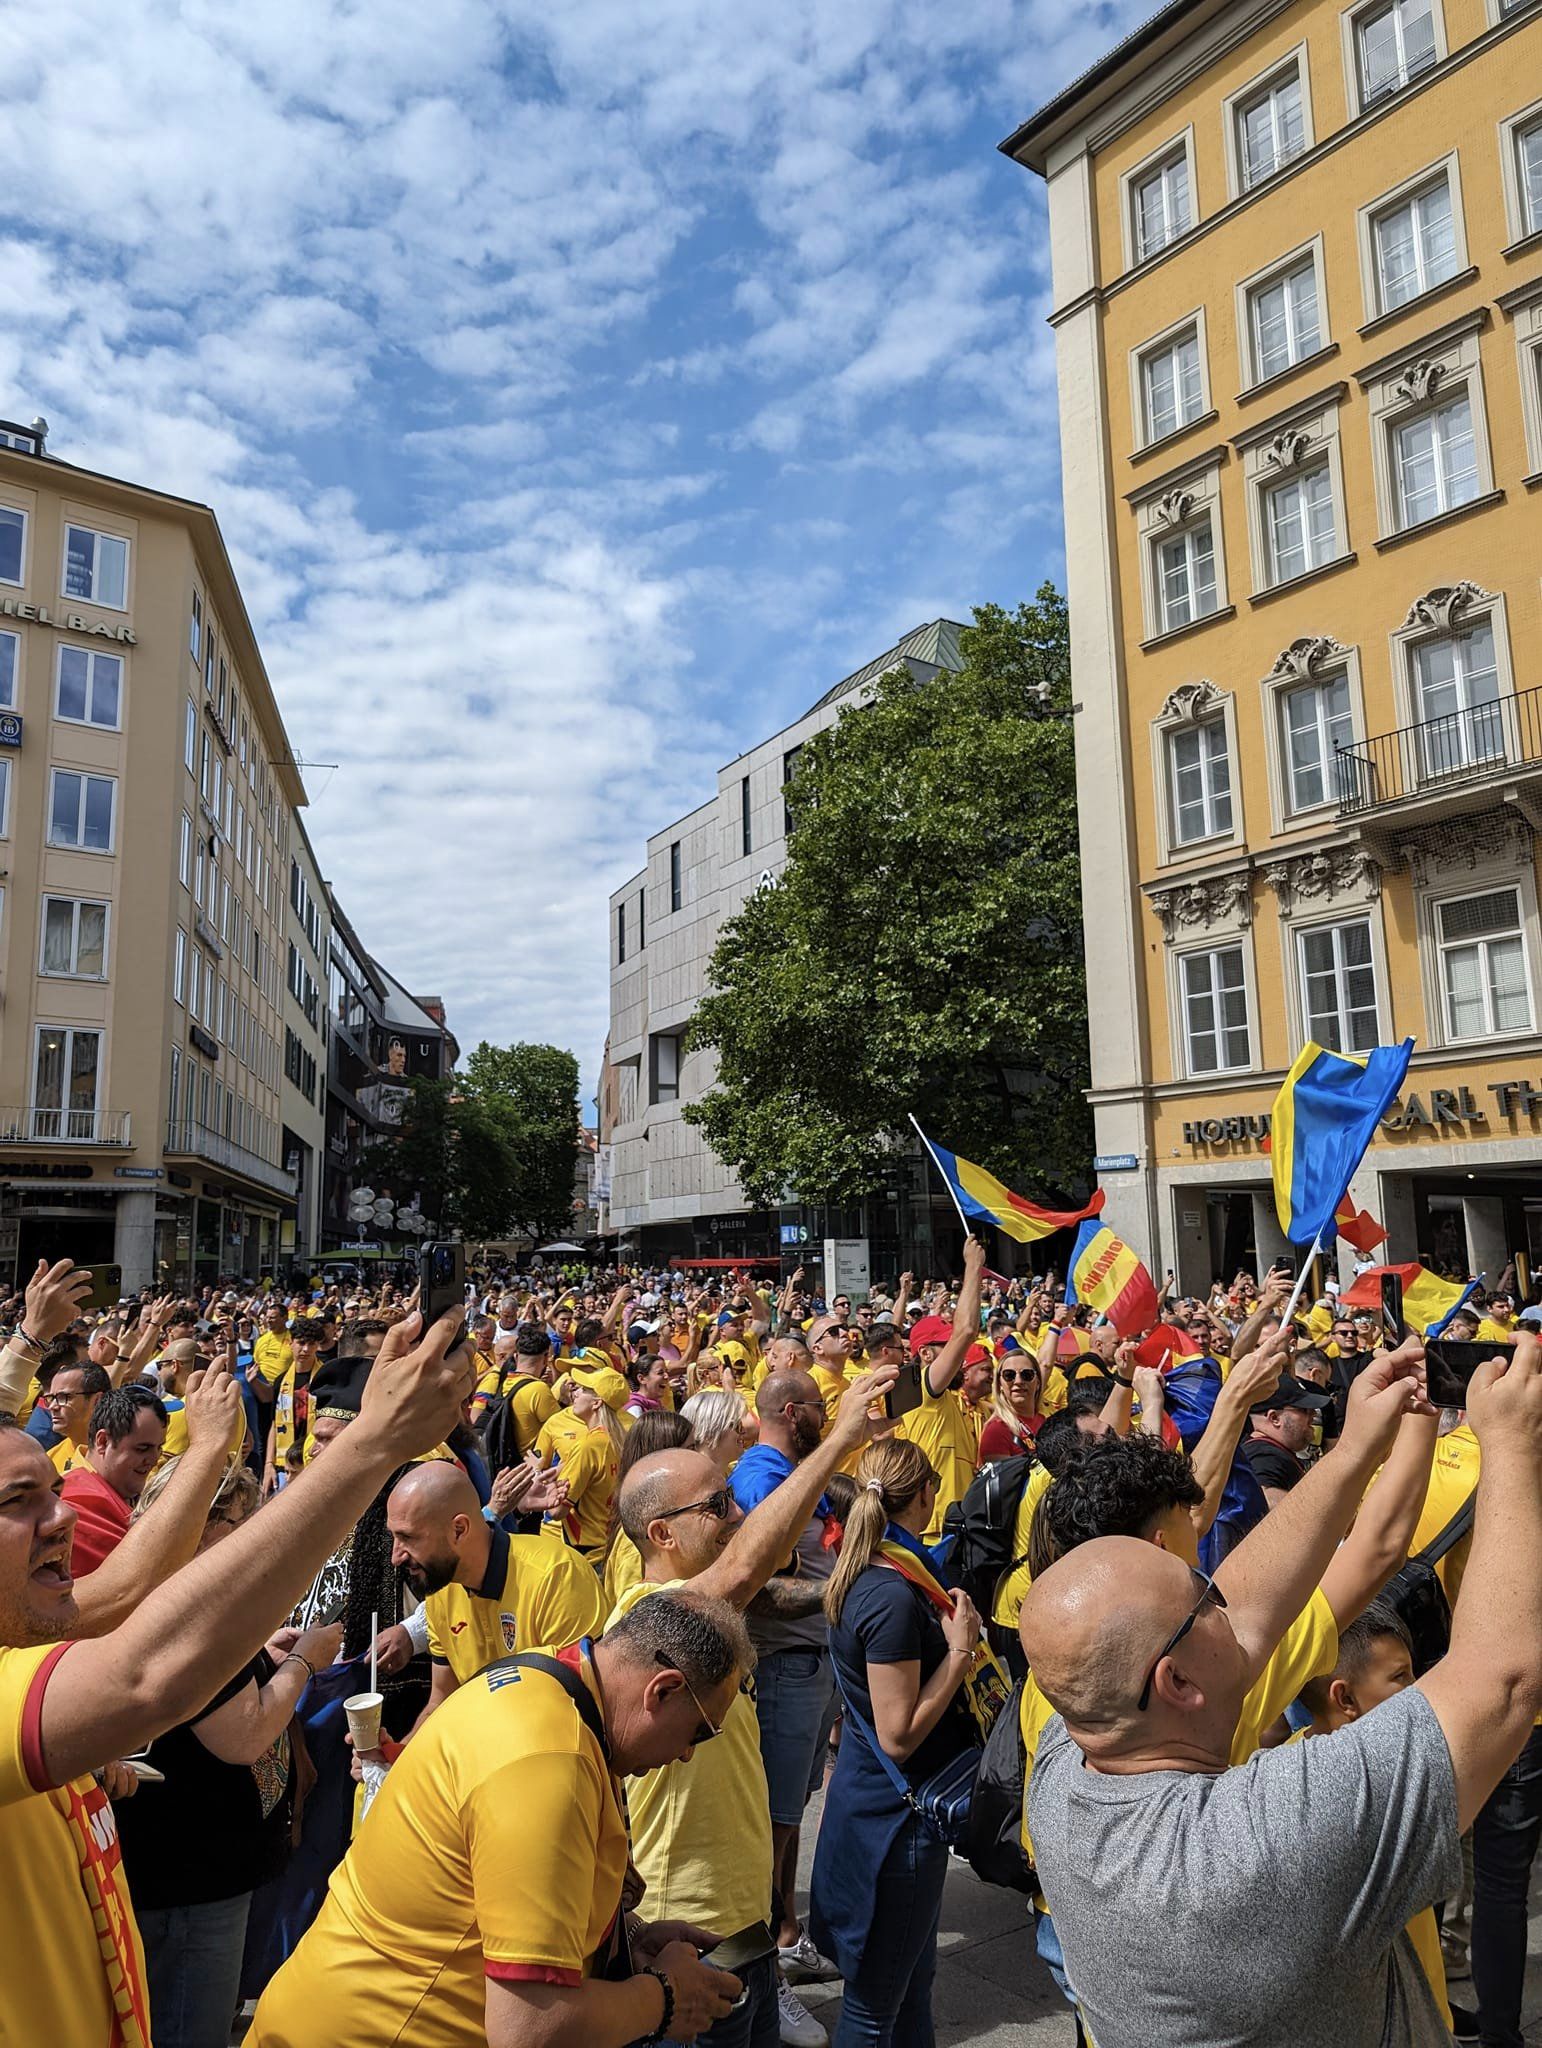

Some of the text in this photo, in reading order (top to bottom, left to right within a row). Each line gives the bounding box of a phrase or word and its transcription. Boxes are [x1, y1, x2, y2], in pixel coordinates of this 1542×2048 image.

[67, 613, 137, 645] BAR
[1098, 1156, 1131, 1168] Marienplatz
[719, 1220, 746, 1230] GALERIA
[791, 1226, 807, 1241] U S
